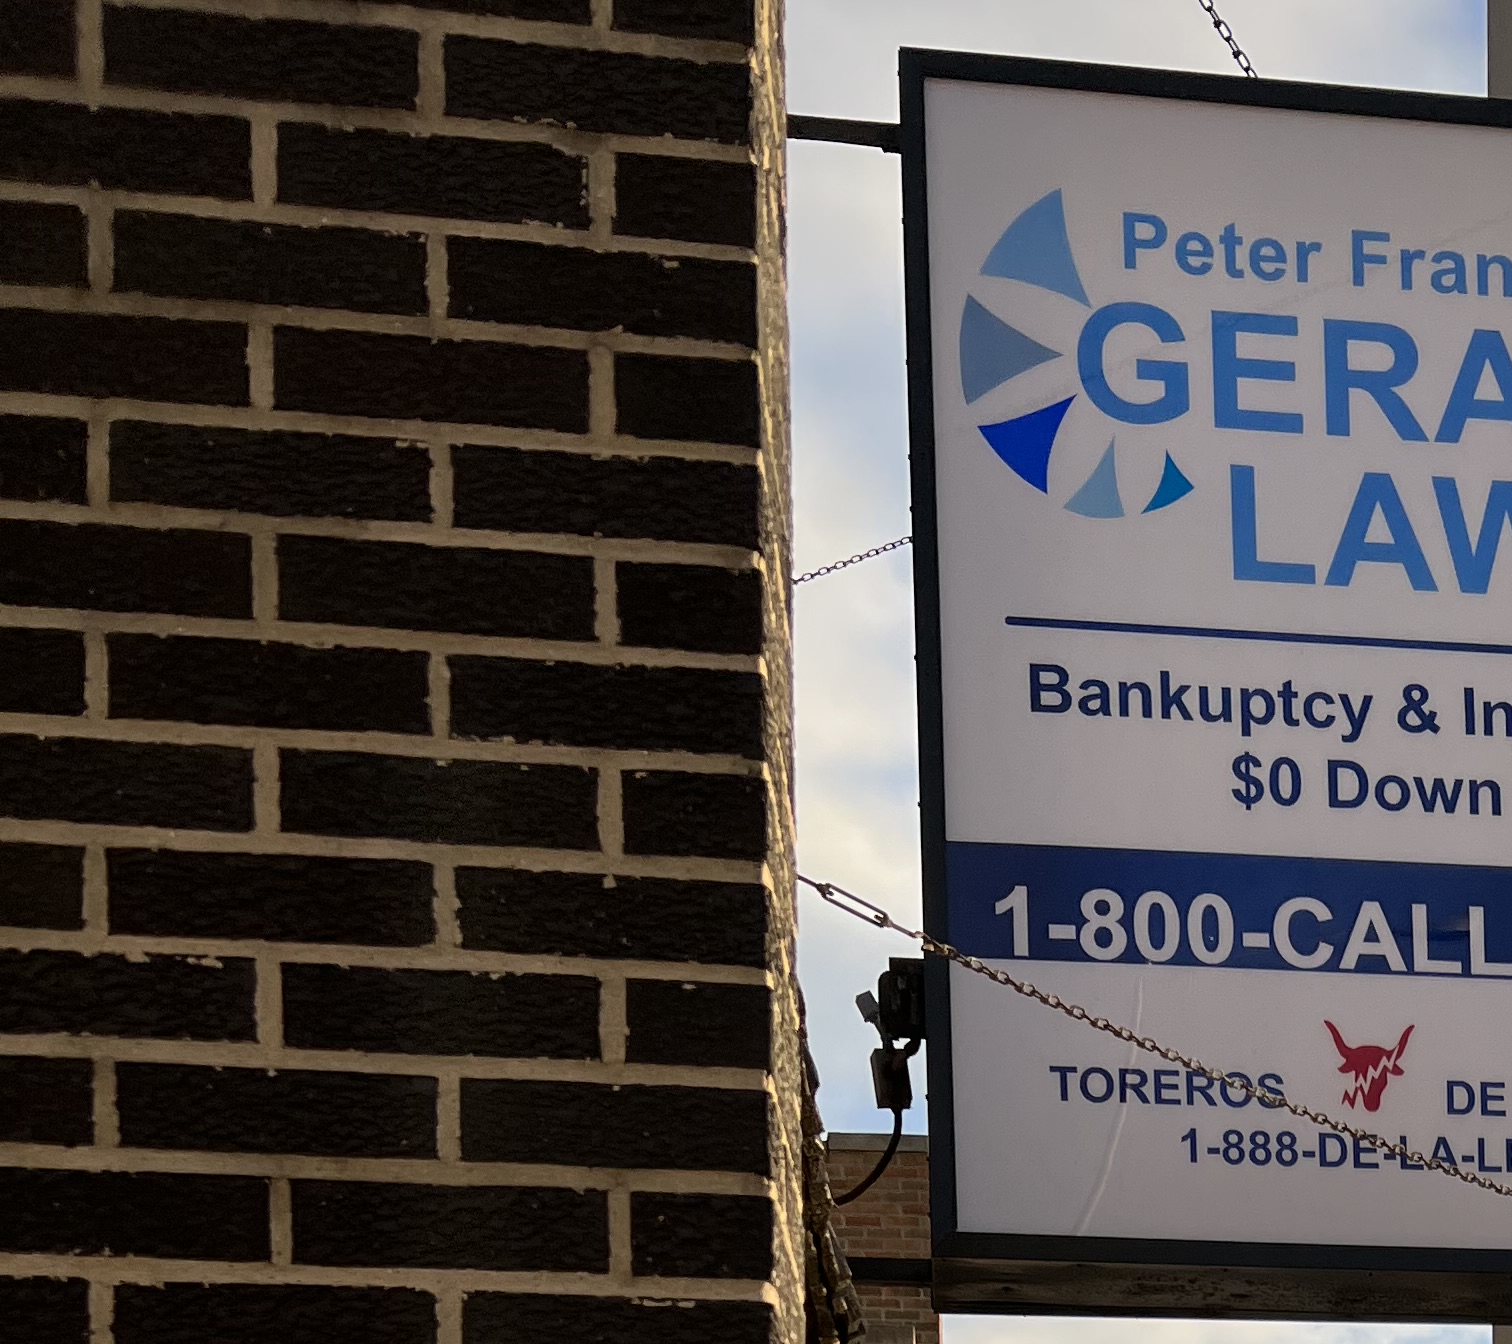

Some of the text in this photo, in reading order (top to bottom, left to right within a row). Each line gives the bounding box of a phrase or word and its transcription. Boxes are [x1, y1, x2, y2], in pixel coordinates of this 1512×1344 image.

[1123, 212, 1321, 283] Peter
[1029, 663, 1372, 743] Bankuptcy
[1397, 684, 1440, 735] &
[1231, 752, 1503, 817] $0 Down
[1050, 1065, 1286, 1110] TOREROS
[1446, 1080, 1505, 1118] DE
